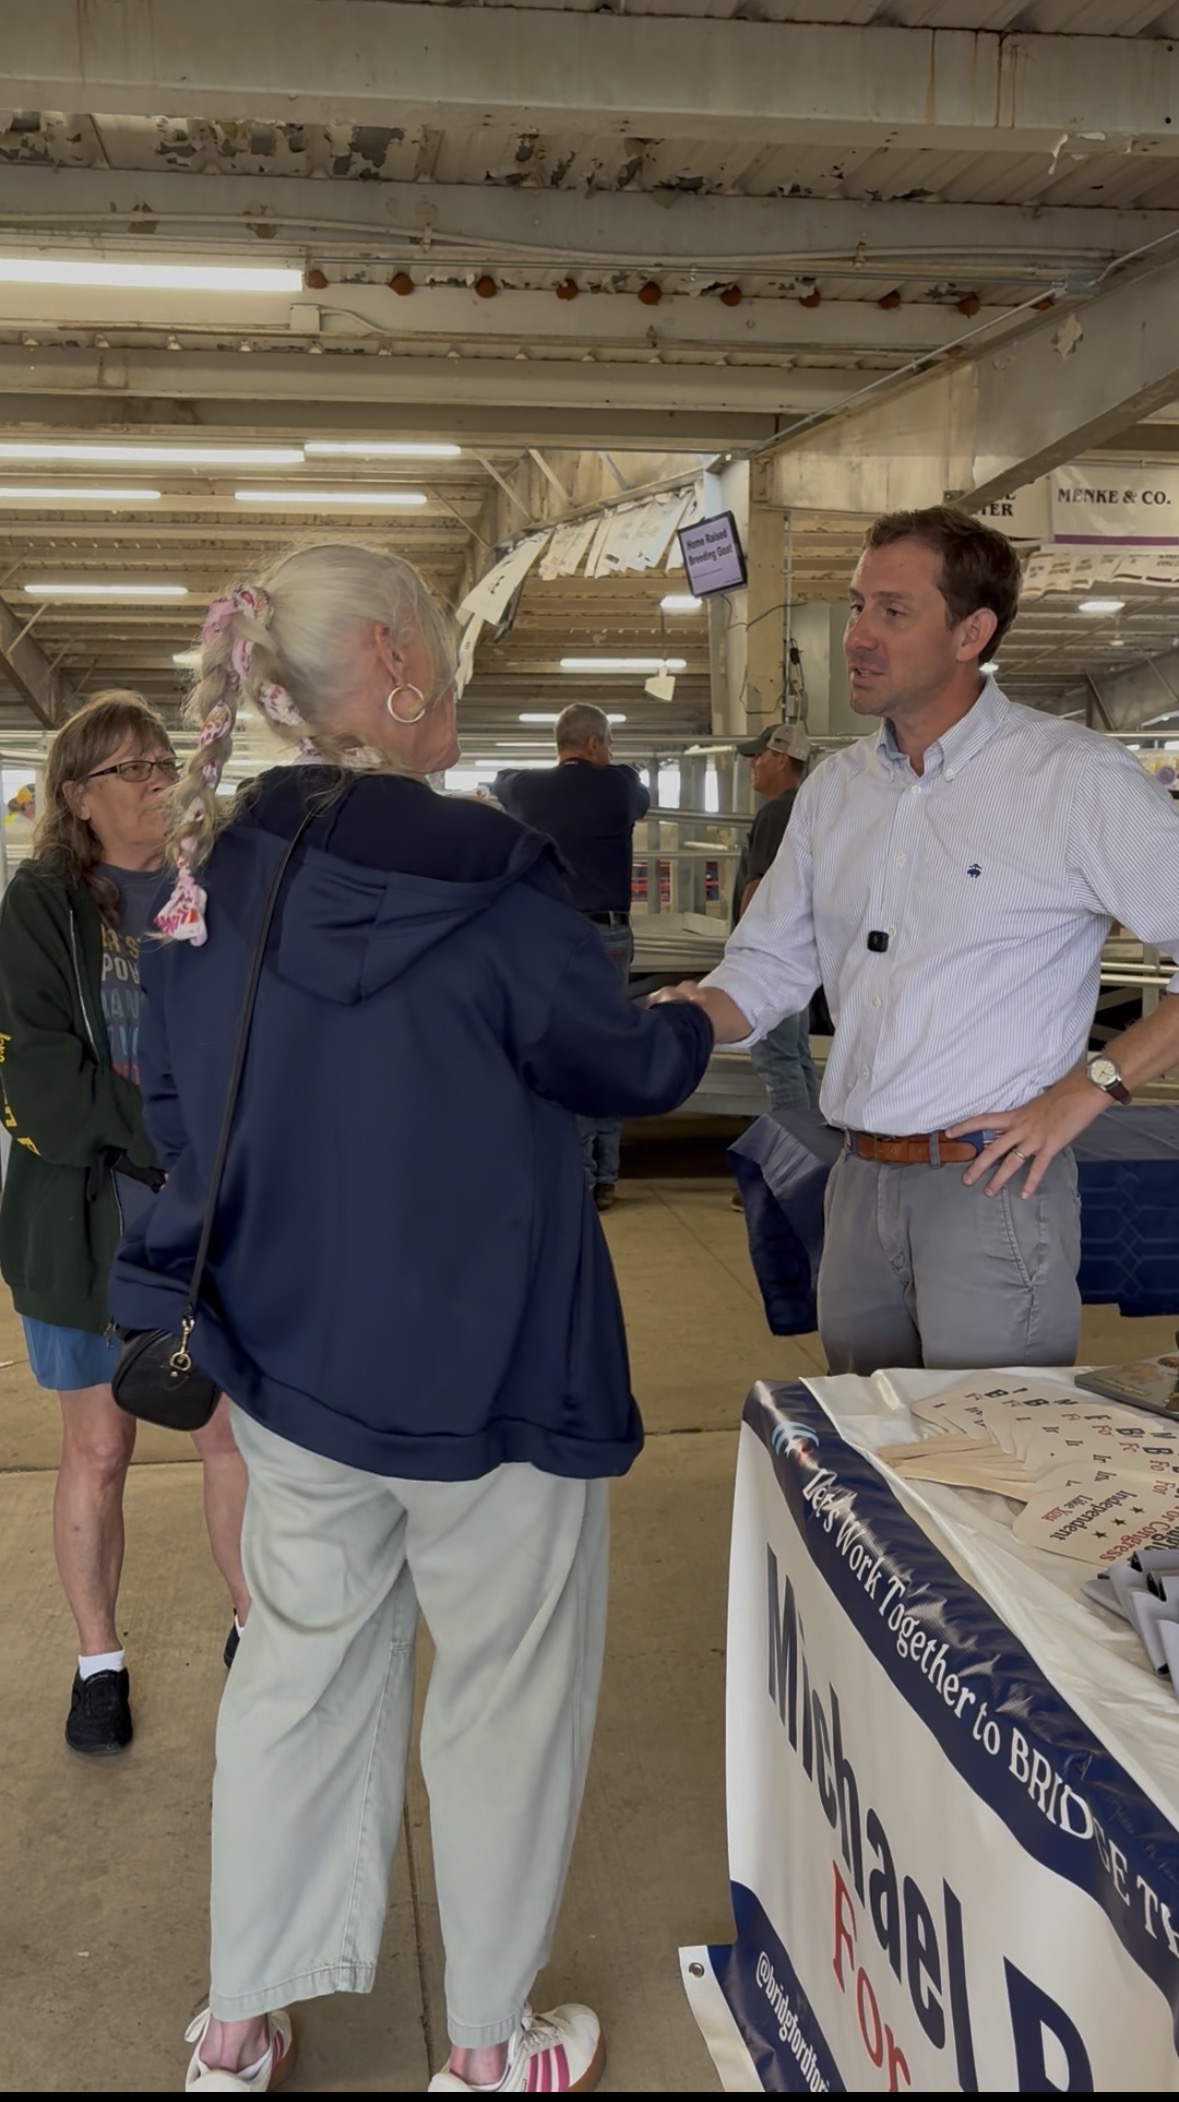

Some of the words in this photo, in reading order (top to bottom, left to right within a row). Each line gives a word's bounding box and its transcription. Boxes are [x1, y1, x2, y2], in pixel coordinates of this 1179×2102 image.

[1058, 488, 1119, 504] MENKE
[1122, 491, 1136, 504] &
[1141, 491, 1172, 505] CO.
[705, 527, 728, 544] Raised
[688, 550, 717, 566] Breeding
[1041, 1506, 1074, 1522] You
[1050, 1490, 1138, 1541] Independent
[1064, 1494, 1094, 1510] Like
[1100, 1521, 1171, 1562] Congress
[836, 1512, 885, 1600] Work
[879, 1574, 976, 1718] Together
[973, 1702, 1001, 1755] to
[1008, 1727, 1130, 1907] BRIDGE
[766, 1543, 978, 2092] Michael
[832, 1860, 911, 2092] For
